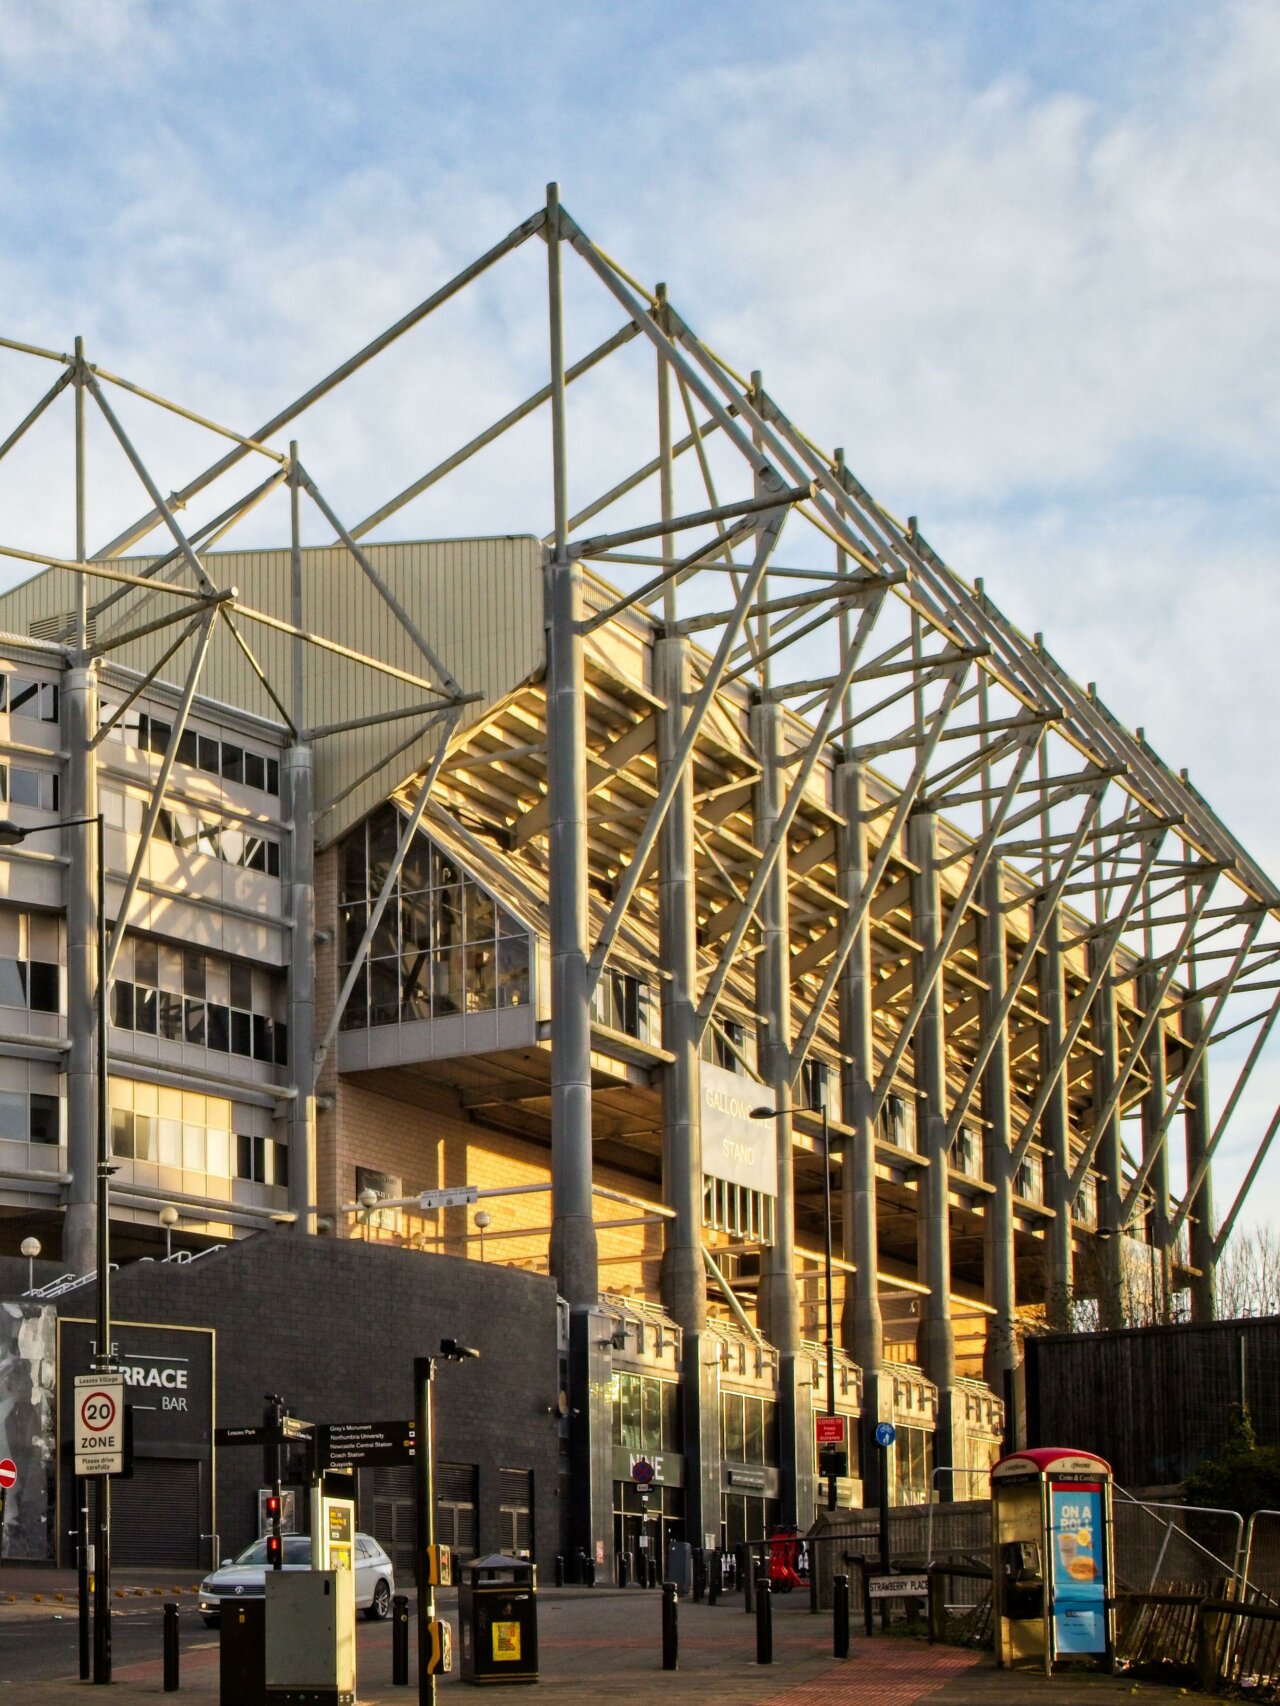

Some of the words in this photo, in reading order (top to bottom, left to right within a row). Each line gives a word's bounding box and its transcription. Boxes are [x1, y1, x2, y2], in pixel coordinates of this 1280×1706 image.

[723, 1139, 754, 1165] STAND
[90, 1341, 119, 1356] TE
[90, 1364, 188, 1389] RRACE
[99, 1376, 118, 1384] Village
[87, 1404, 110, 1420] 20
[162, 1397, 188, 1412] BAR
[81, 1436, 115, 1449] ZONE
[1061, 1505, 1079, 1519] ON
[1082, 1506, 1092, 1519] A
[870, 1581, 907, 1592] STRAWBERRY
